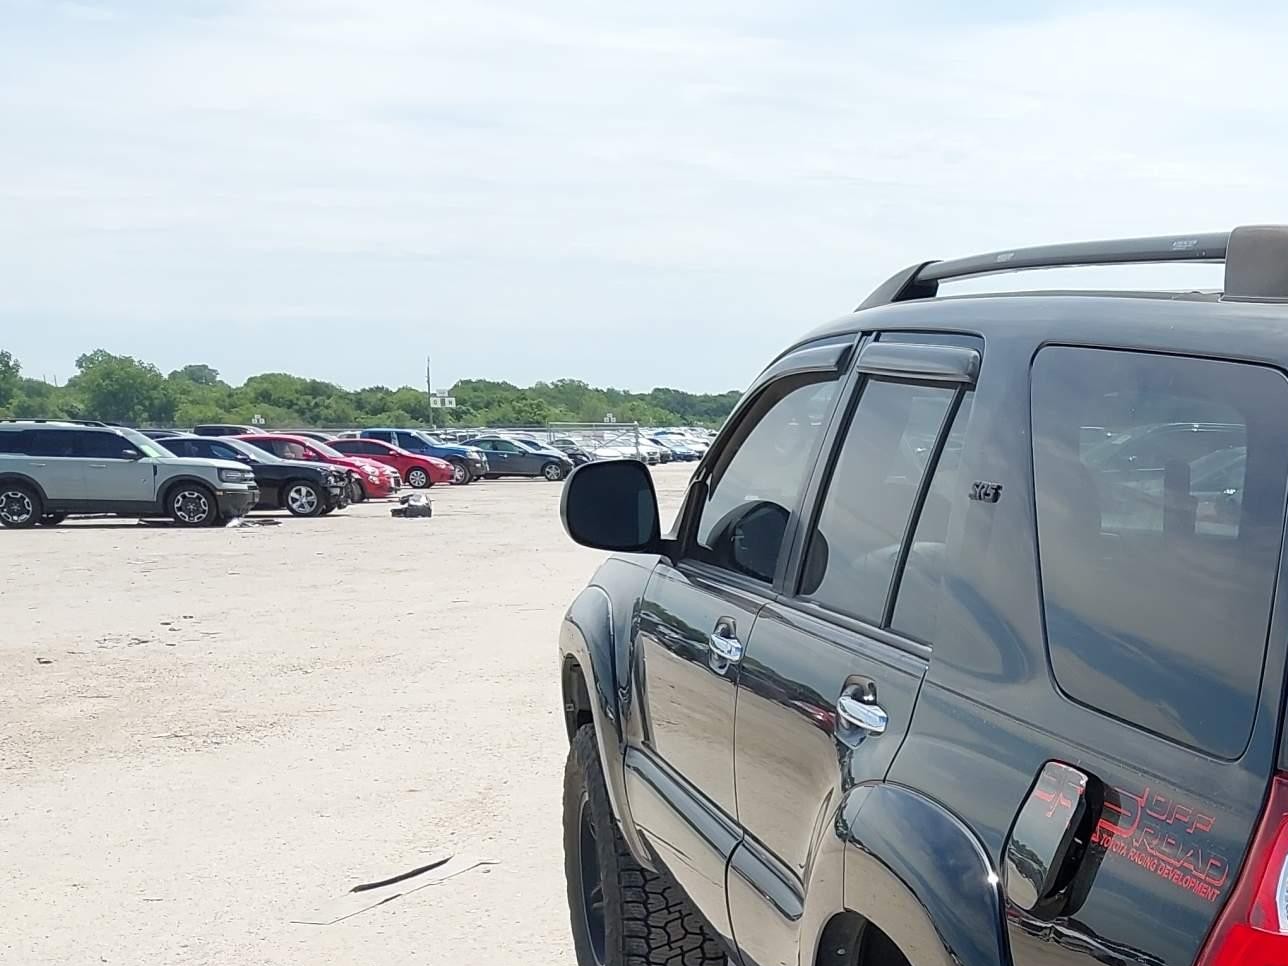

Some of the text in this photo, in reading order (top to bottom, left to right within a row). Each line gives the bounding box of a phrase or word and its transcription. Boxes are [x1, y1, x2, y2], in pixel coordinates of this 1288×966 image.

[1145, 791, 1216, 834] OFF
[1099, 833, 1222, 903] TOYOTA RACING DEVELOPMENT
[1133, 821, 1229, 885] ROAD
